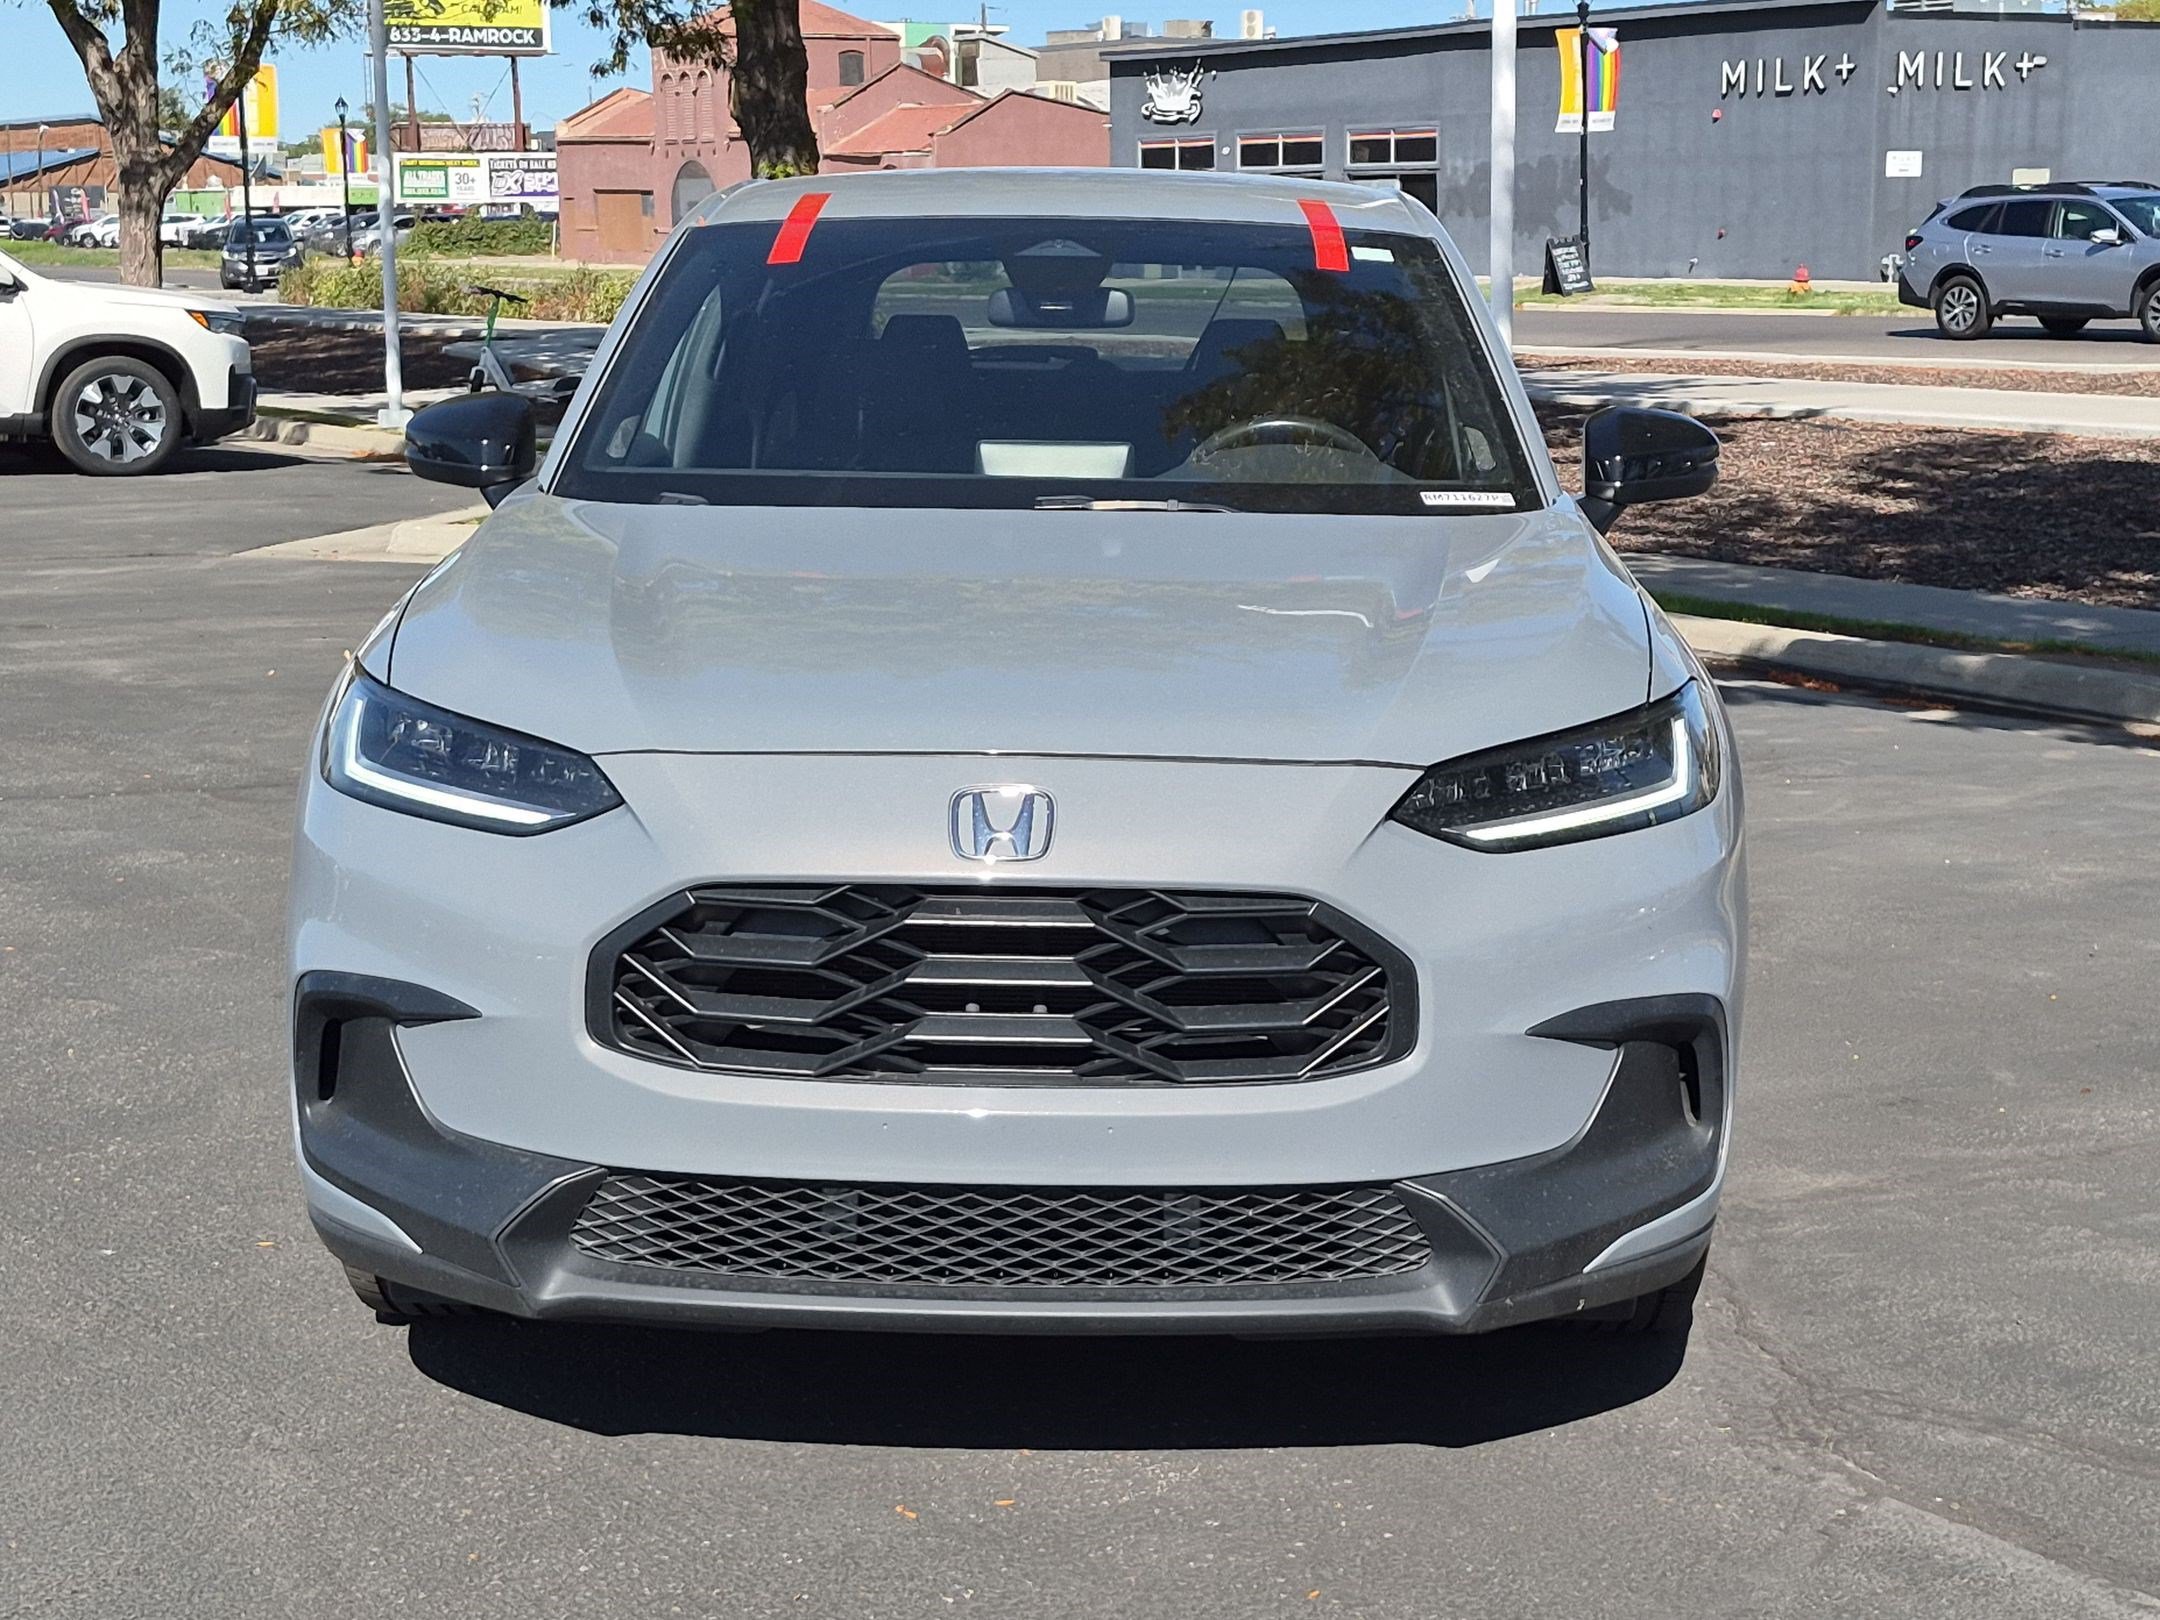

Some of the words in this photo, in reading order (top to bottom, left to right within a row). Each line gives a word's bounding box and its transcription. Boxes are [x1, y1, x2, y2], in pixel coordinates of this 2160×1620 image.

[1720, 53, 1856, 97] MILK+
[1897, 50, 2035, 89] MILK+
[455, 172, 476, 185] 30+
